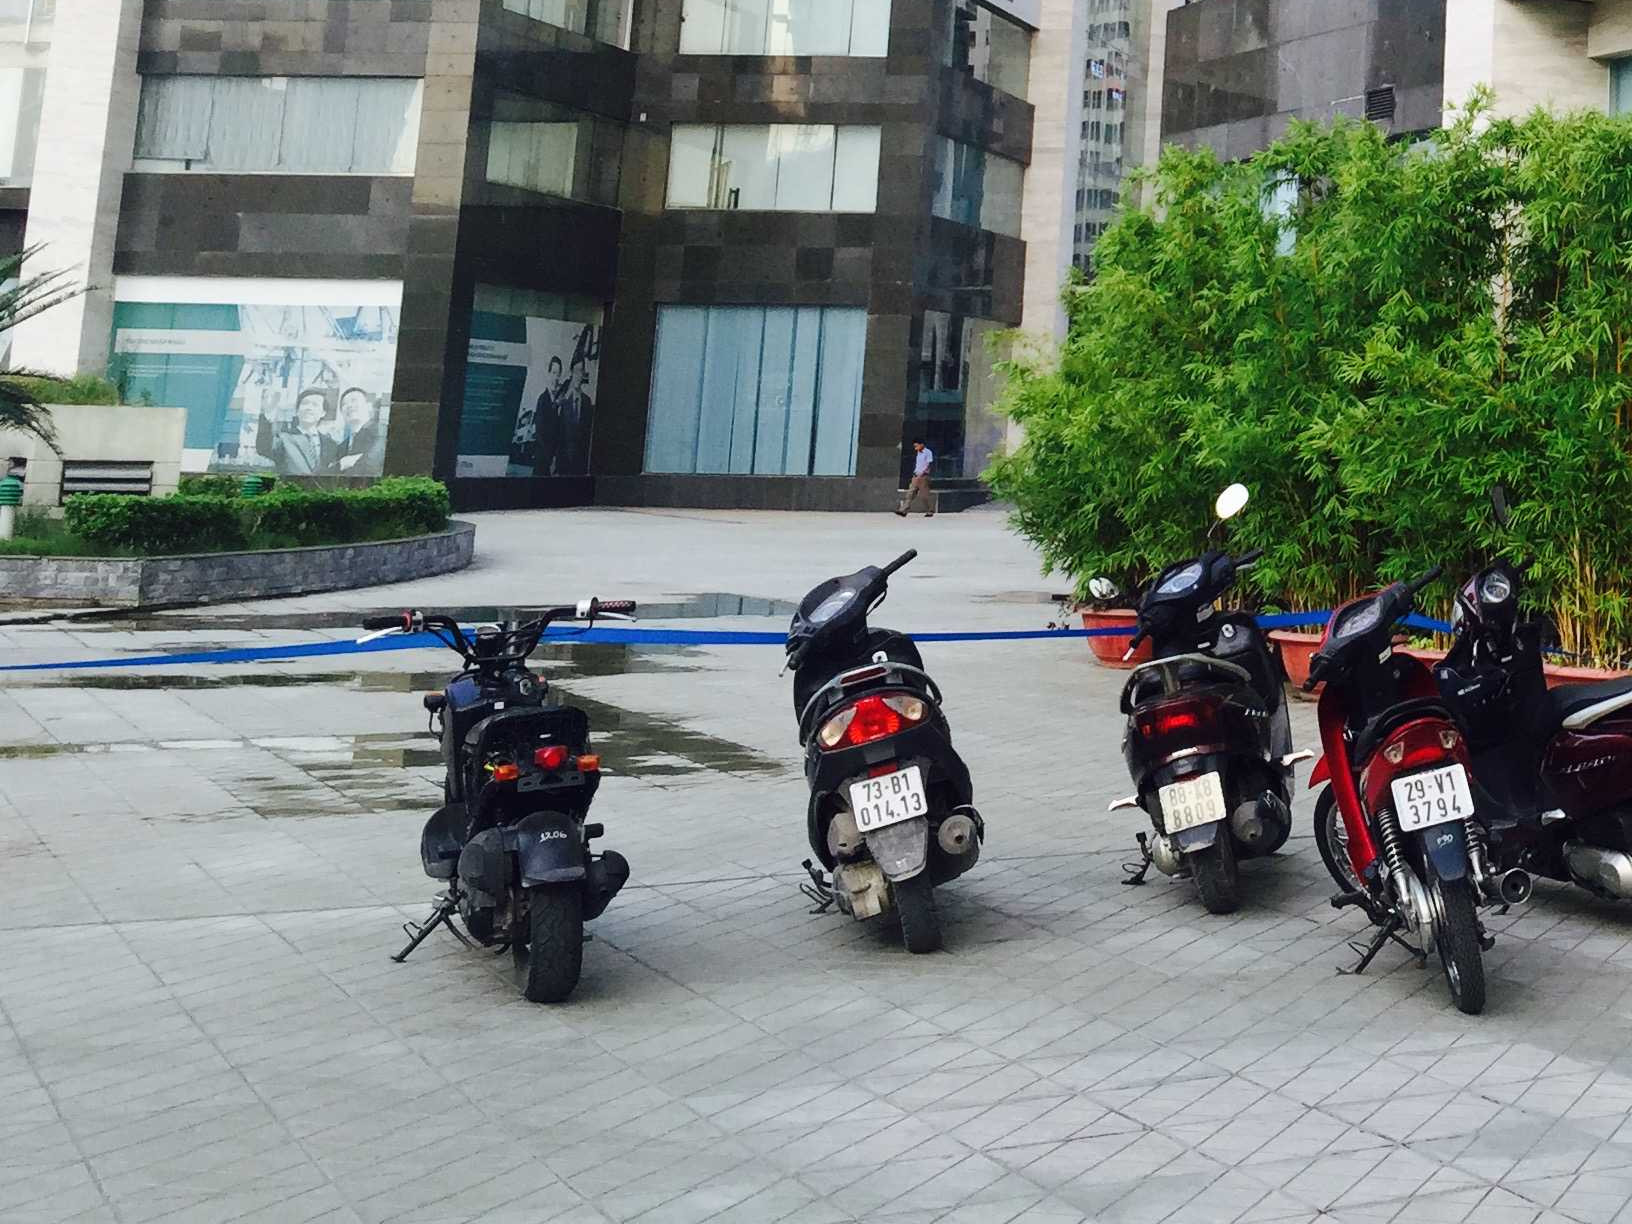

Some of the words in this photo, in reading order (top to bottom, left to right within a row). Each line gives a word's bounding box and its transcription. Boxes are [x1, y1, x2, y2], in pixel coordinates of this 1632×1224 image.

[861, 772, 910, 803] 73-B1
[1403, 771, 1456, 803] 29-V1
[860, 792, 922, 826] 014.13
[1409, 794, 1461, 825] 3794
